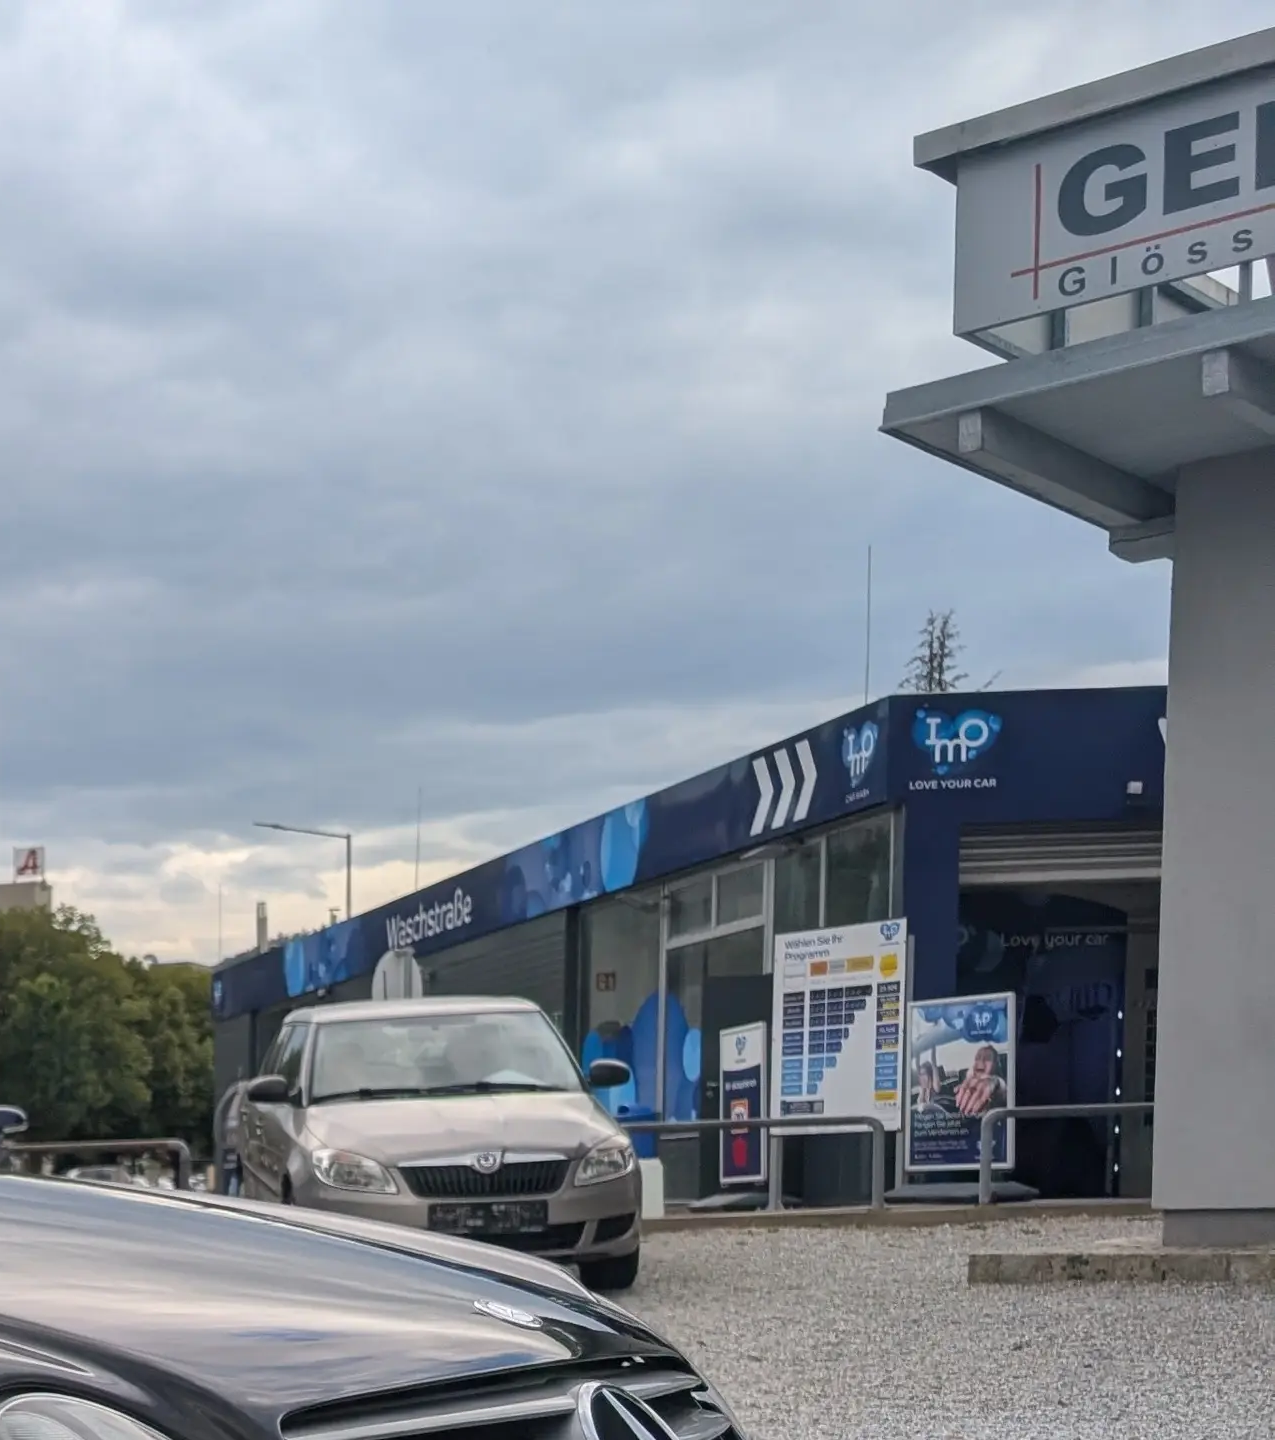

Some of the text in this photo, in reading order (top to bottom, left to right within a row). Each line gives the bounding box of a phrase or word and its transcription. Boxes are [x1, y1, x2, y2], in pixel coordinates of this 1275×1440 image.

[1057, 101, 1275, 236] GE
[909, 778, 997, 790] LOVE YOUR CAR
[386, 887, 472, 951] Waschstraße
[1000, 932, 1109, 950] Love your car
